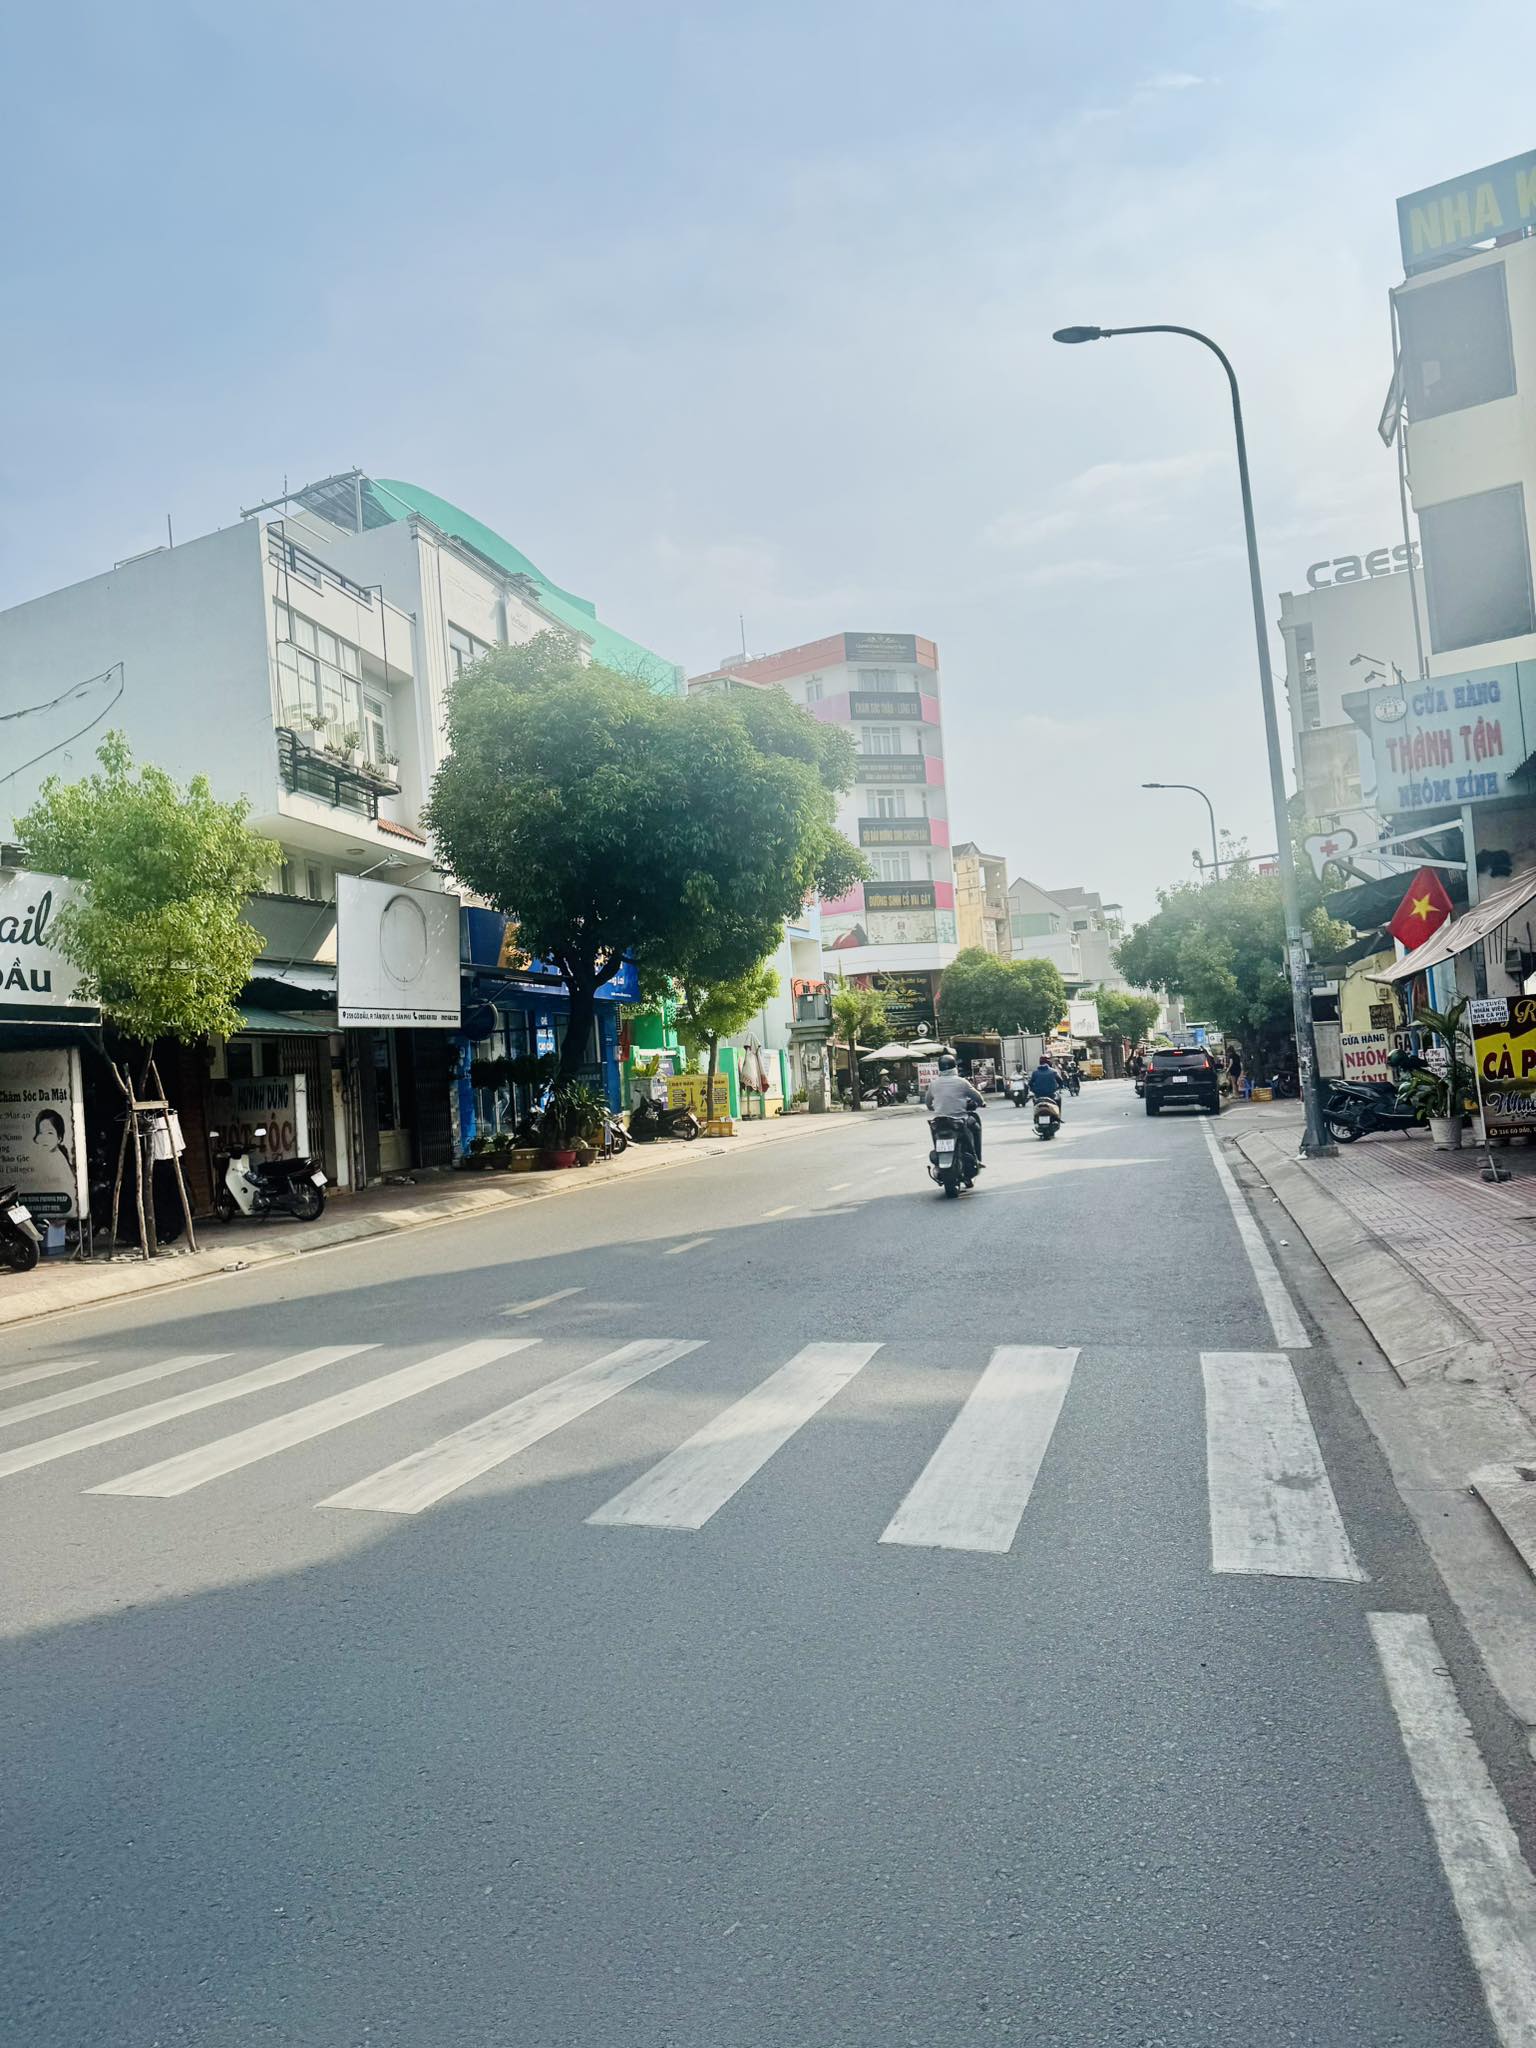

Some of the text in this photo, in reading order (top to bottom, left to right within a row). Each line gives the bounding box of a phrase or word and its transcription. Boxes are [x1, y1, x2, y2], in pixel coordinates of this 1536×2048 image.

[1410, 182, 1504, 256] NHA
[1412, 680, 1501, 716] CỬA HÀNG
[1386, 716, 1503, 774] THÀNH TÂM
[1398, 769, 1499, 808] NHÔM KÍNH
[0, 957, 52, 992] ẦU
[1342, 1032, 1386, 1046] CỬA HÀNG
[1394, 1033, 1414, 1051] GA
[1345, 1046, 1387, 1068] NHÔM
[1483, 1043, 1515, 1082] CÀ
[38, 1088, 50, 1101] Da
[51, 1087, 67, 1103] Mặt
